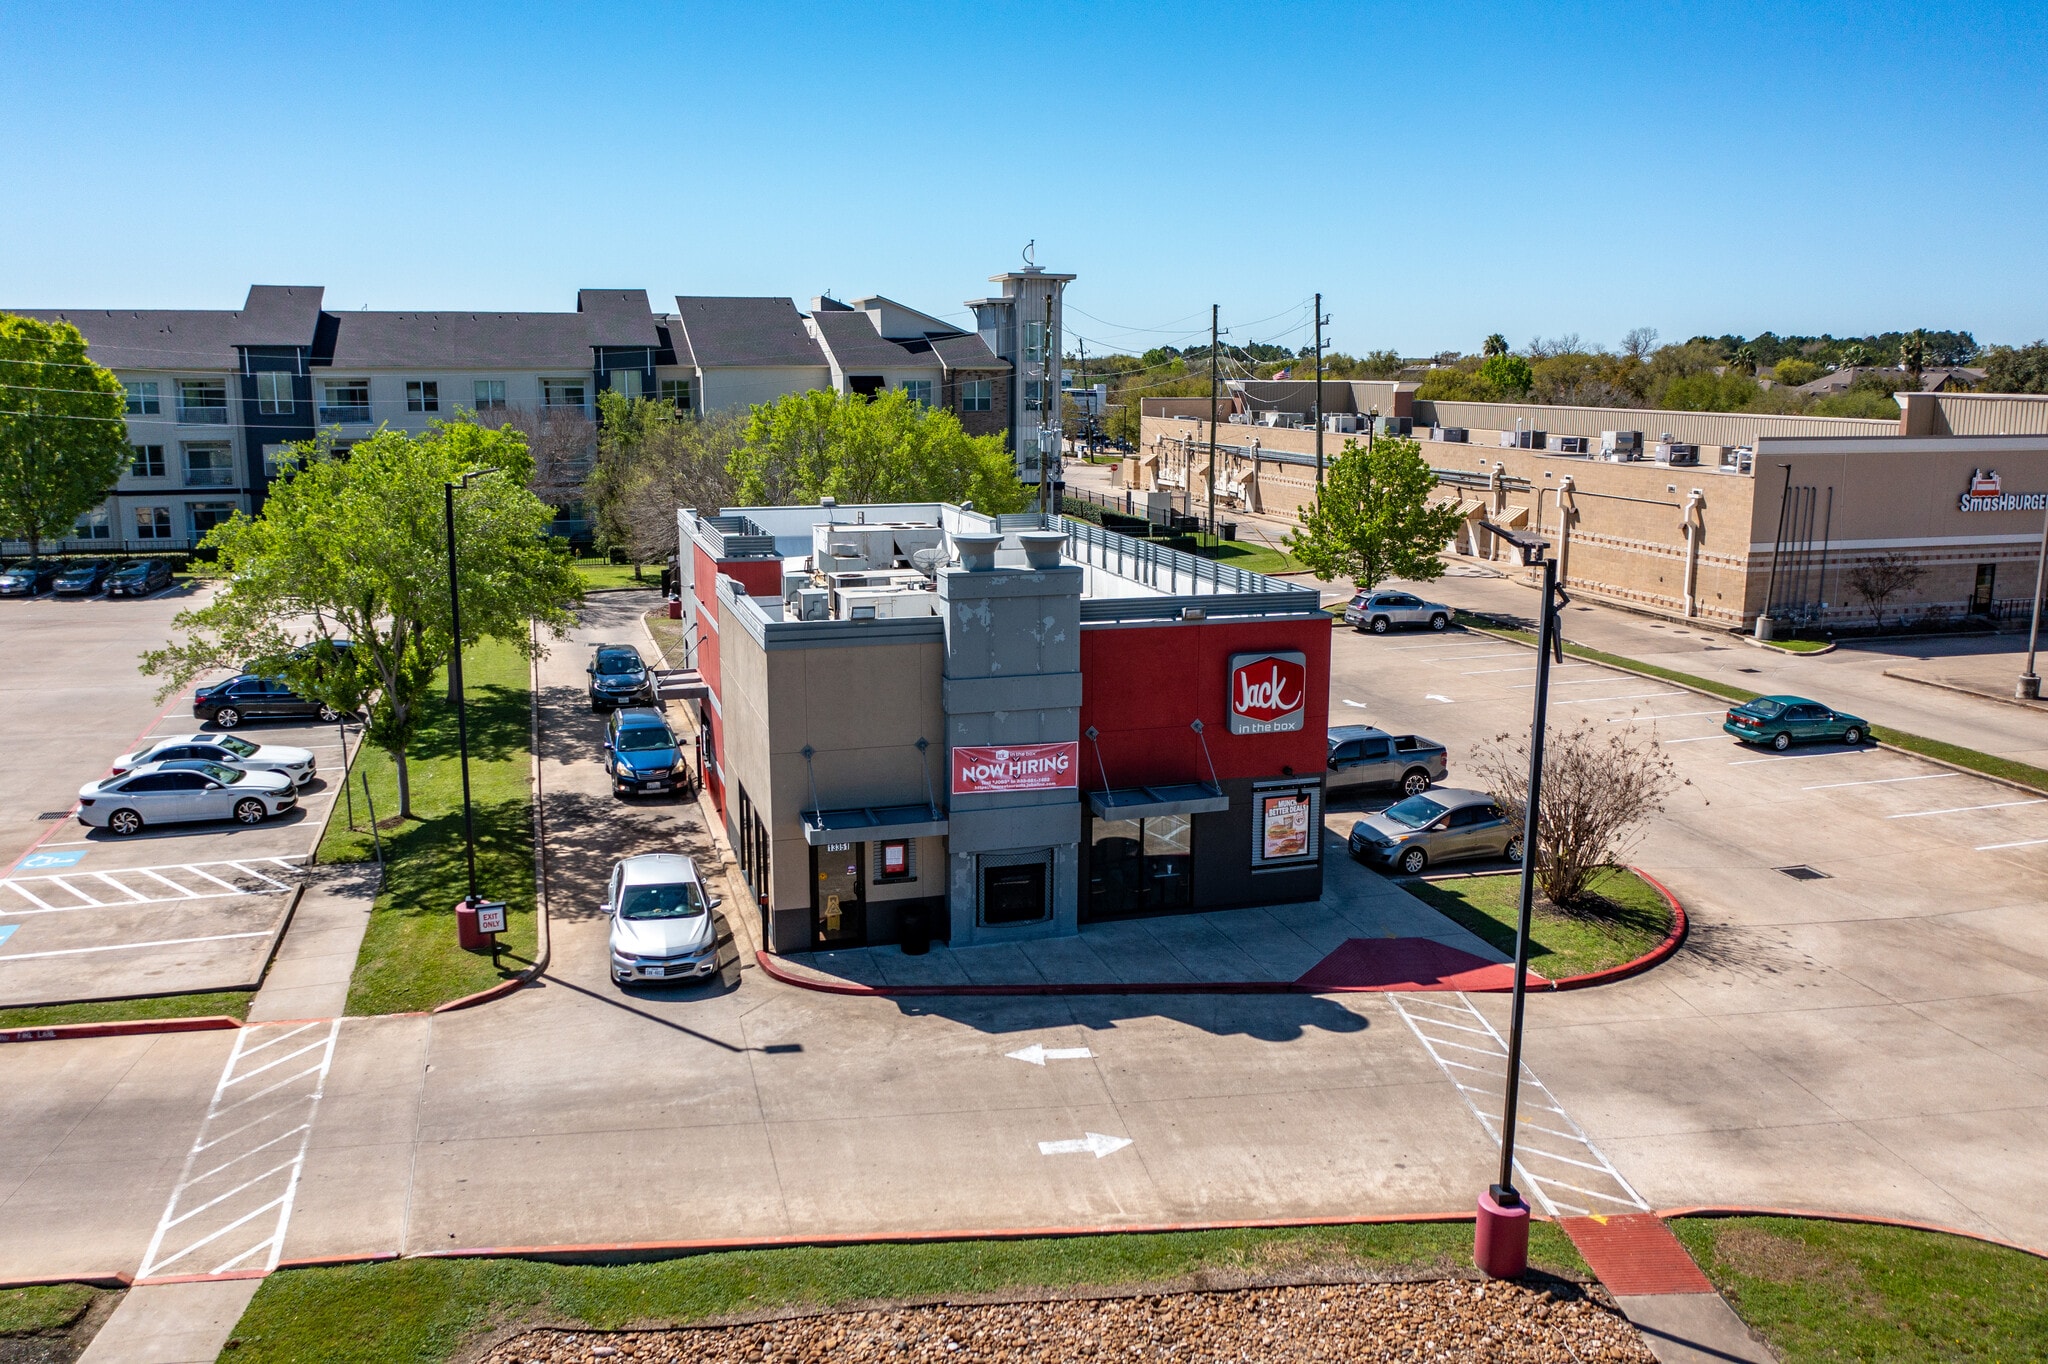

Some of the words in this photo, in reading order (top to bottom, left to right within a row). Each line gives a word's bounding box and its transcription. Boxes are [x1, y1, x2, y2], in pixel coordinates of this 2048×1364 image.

[1235, 665, 1302, 713] Jack
[1239, 724, 1250, 733] in
[1252, 723, 1271, 732] the
[1273, 722, 1296, 731] box
[962, 763, 1005, 782] NOW
[1009, 756, 1069, 776] HIRING
[1269, 807, 1289, 817] BETTER
